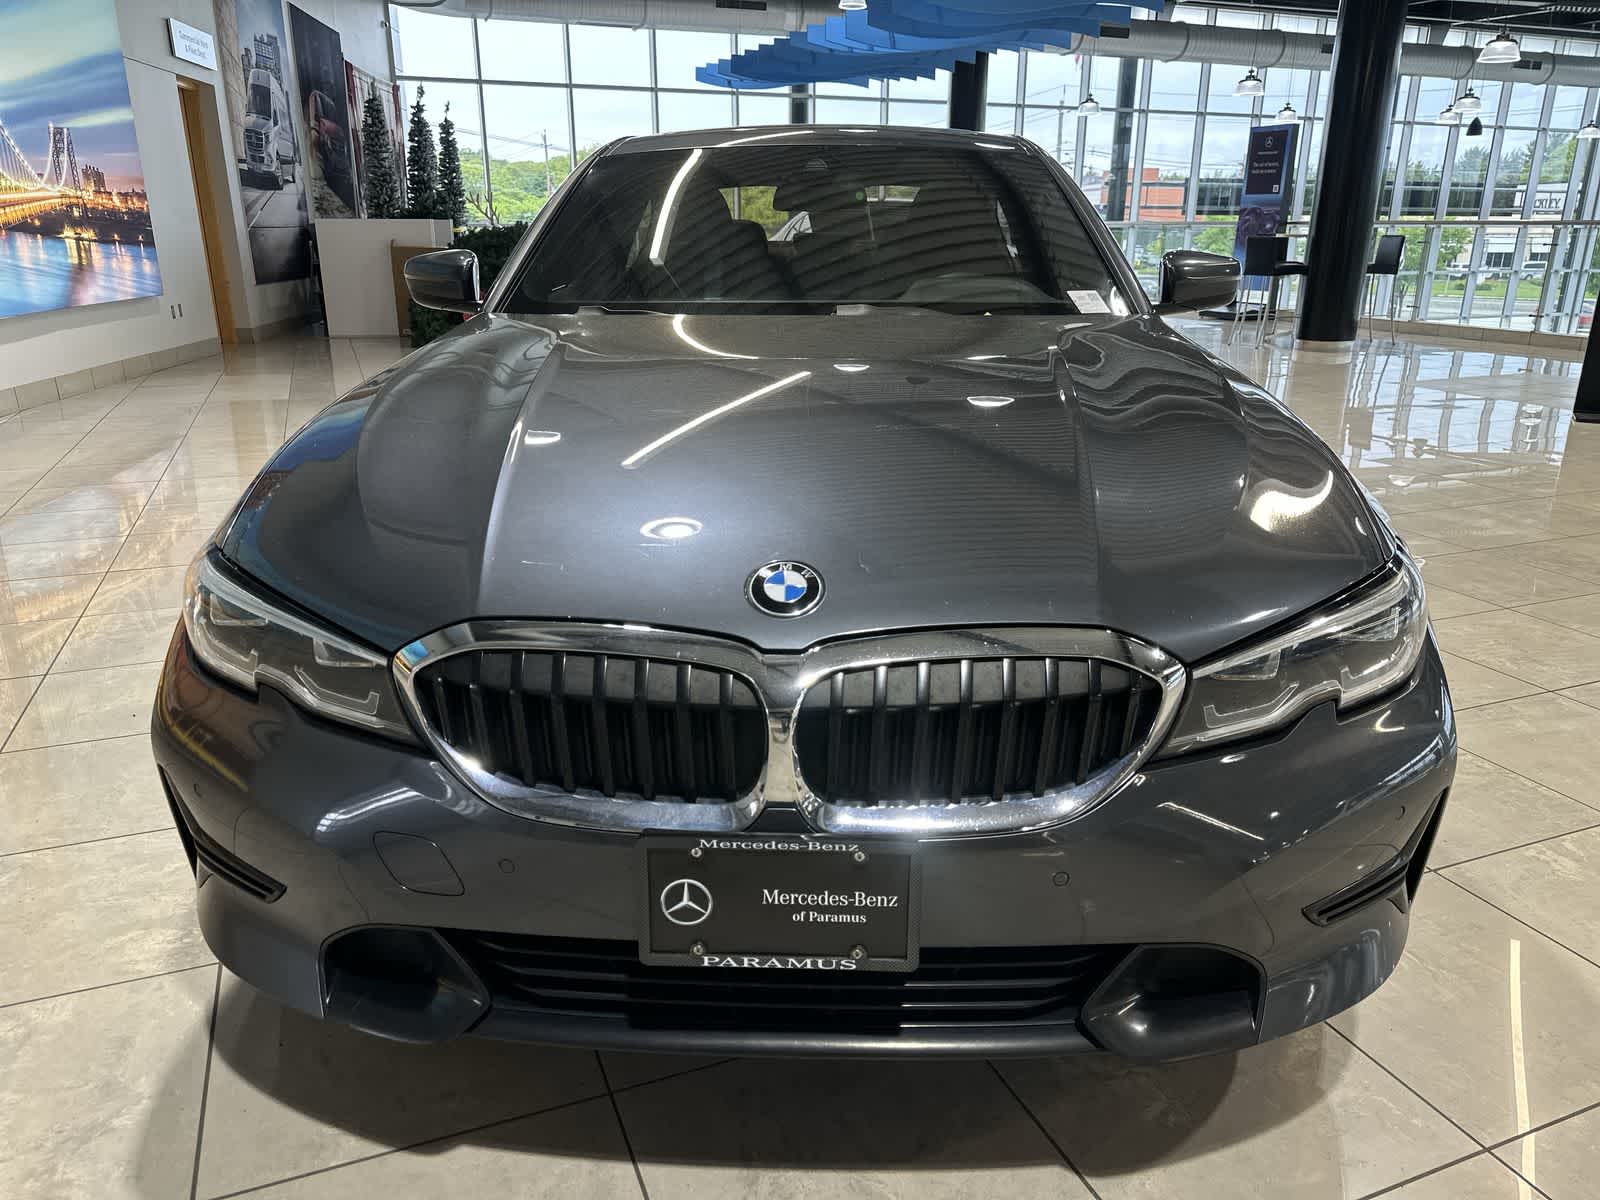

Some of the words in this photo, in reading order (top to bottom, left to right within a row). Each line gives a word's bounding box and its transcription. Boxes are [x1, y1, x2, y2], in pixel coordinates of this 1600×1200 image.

[700, 839, 860, 852] Mercedes-Benz
[762, 889, 898, 907] Mercedes-Benz
[792, 911, 806, 922] of
[808, 911, 867, 923] Paramus
[702, 956, 857, 970] PARAMUS
